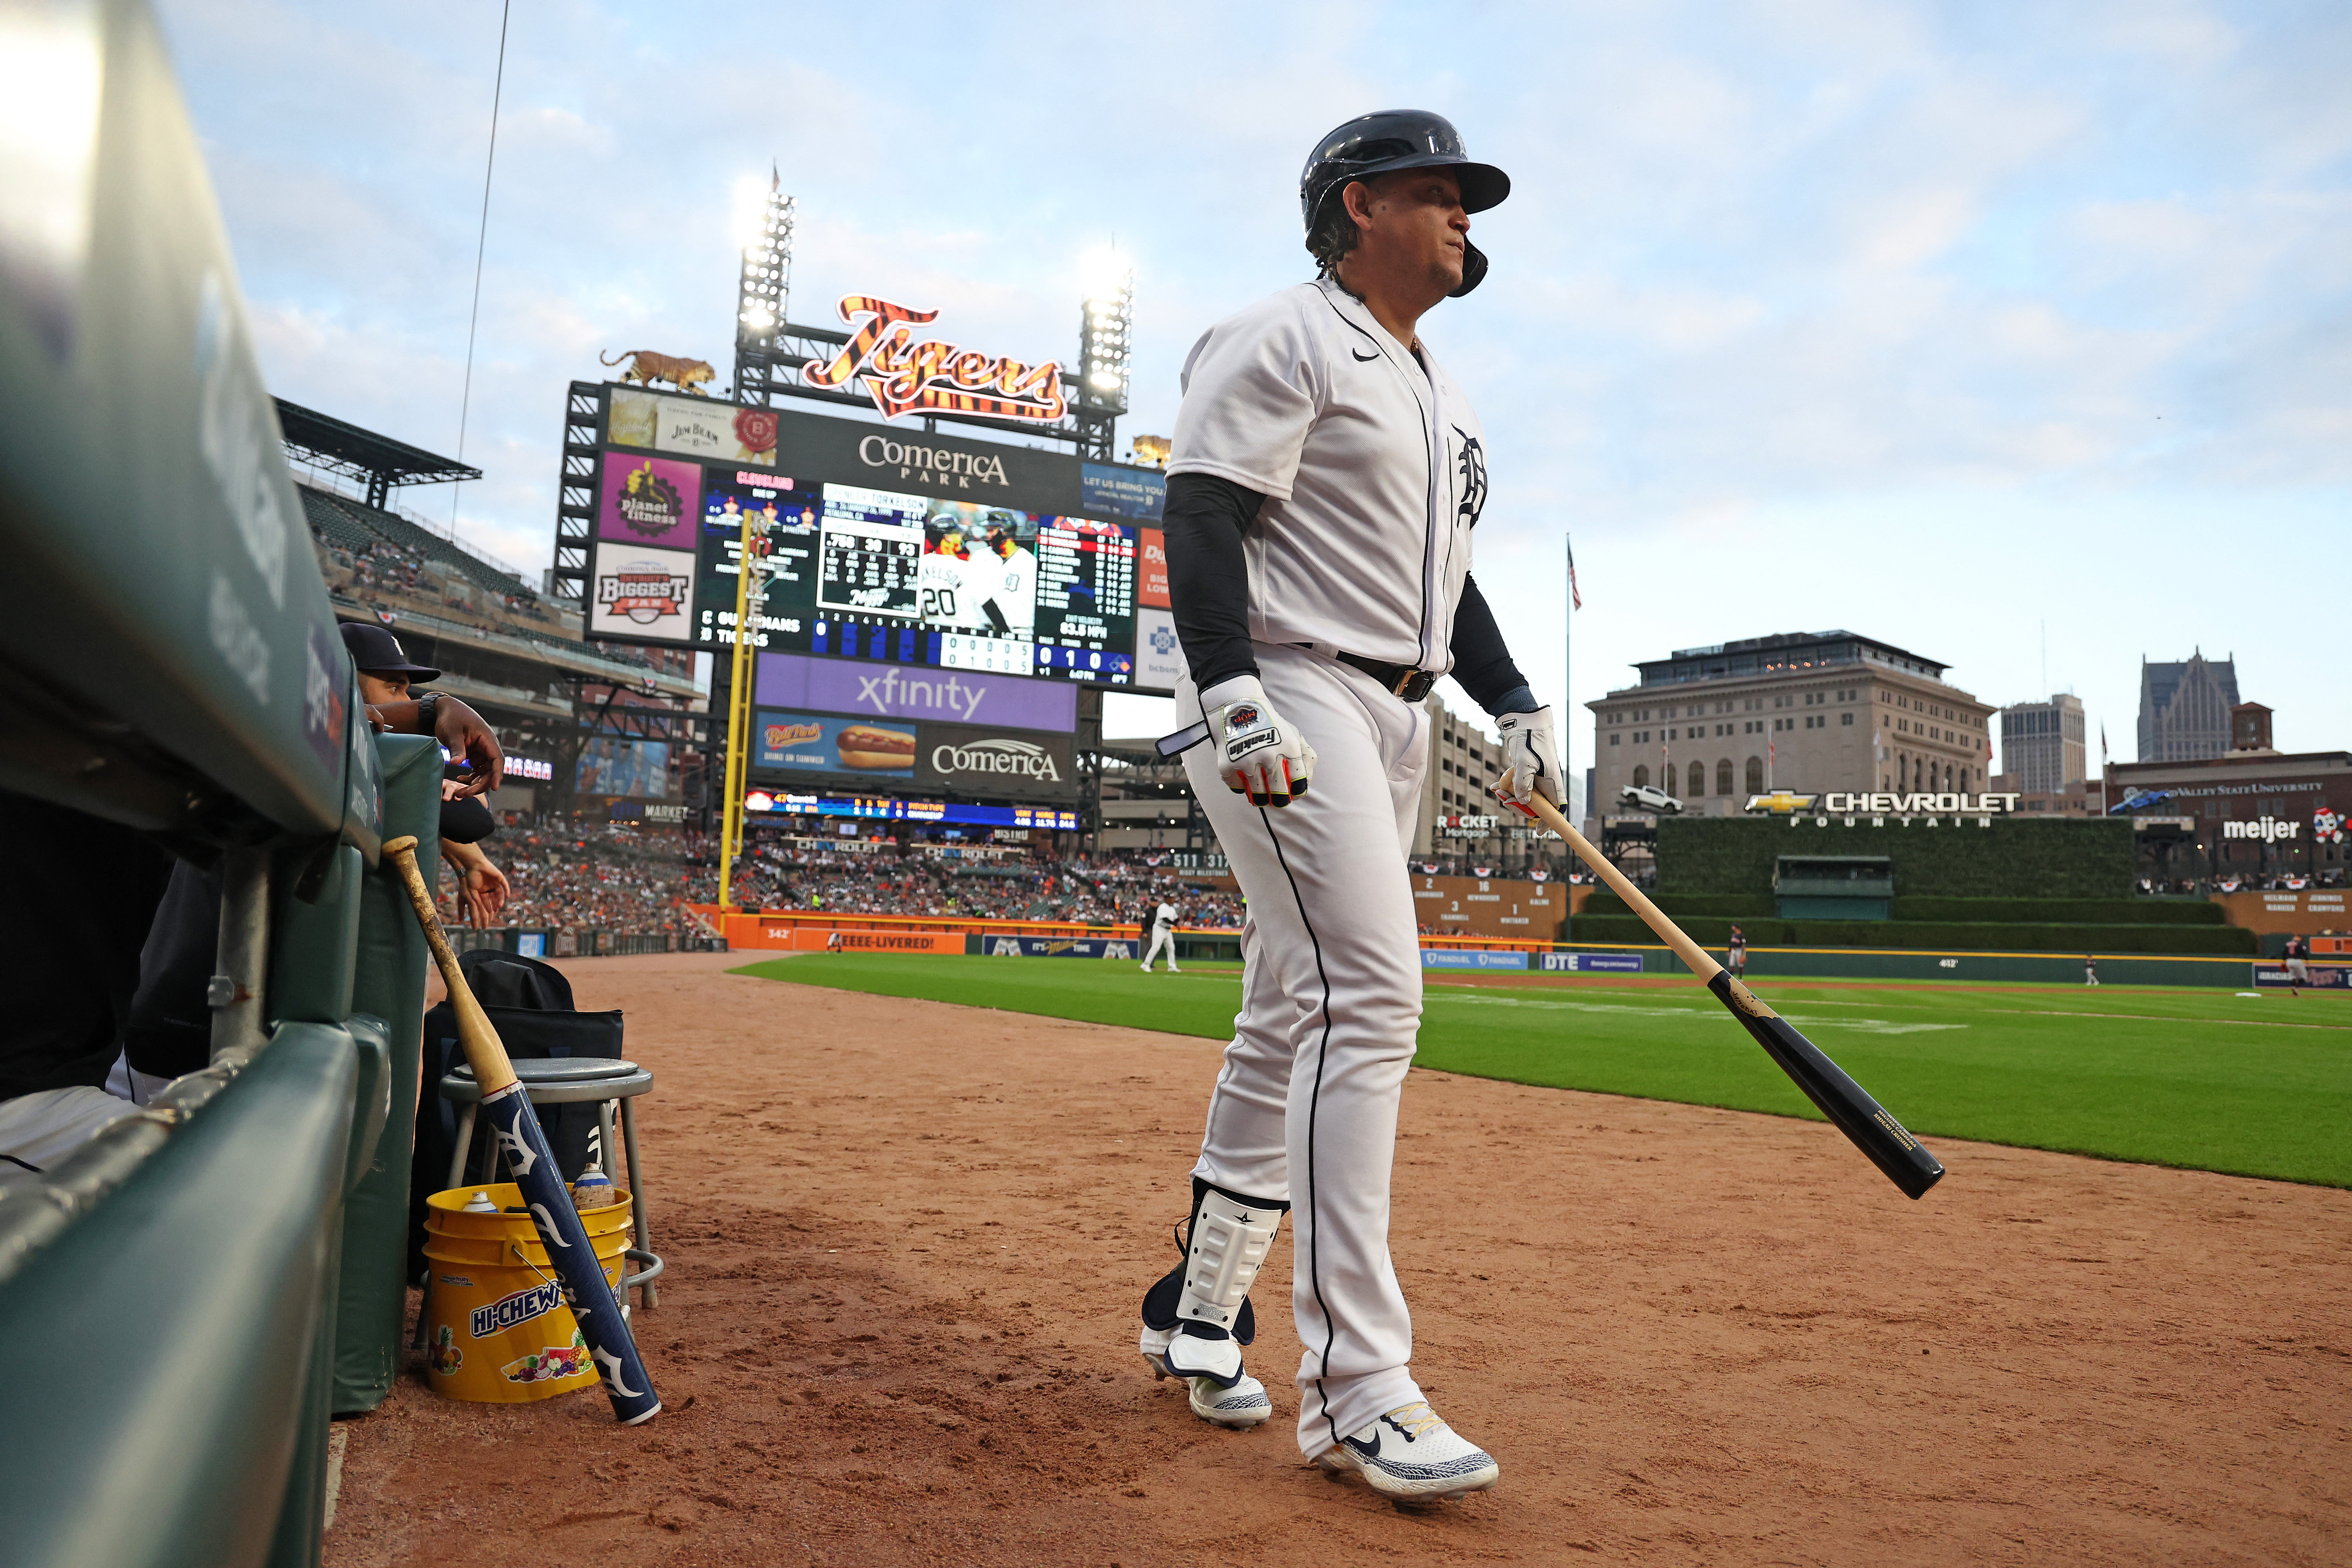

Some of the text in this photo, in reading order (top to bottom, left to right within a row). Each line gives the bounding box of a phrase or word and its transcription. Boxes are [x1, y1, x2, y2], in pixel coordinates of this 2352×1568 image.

[802, 292, 1068, 422] Tigers
[693, 423, 719, 444] BEAM
[736, 471, 794, 491] CLEVELAND
[901, 467, 970, 488] PARK
[1084, 477, 1100, 486] LET
[1102, 479, 1114, 489] US
[826, 488, 867, 501] SPENCER
[621, 497, 668, 514] planet
[627, 508, 677, 525] fitness
[865, 538, 882, 553] 30
[898, 542, 915, 557] 93
[776, 571, 799, 581] NAYLOR
[601, 578, 687, 602] BIGGEST
[628, 598, 662, 607] FAN
[923, 588, 956, 616] 20
[819, 611, 824, 620] 1
[834, 613, 840, 622] 2
[1087, 625, 1107, 639] MPH
[951, 638, 1027, 655] 0 0 0 0 5
[950, 654, 1026, 671] 0 1 0 0 5
[1040, 647, 1101, 669] 0 1 0
[1084, 671, 1095, 681] PM
[856, 668, 986, 720] xfinity
[1234, 711, 1256, 722] MVP
[2178, 782, 2323, 798] VALLEY STATE UNIVERSITY
[774, 794, 787, 803] 47
[1825, 792, 2021, 813] CHEVROLET
[645, 804, 689, 819] MARKET
[1437, 815, 1499, 828] ROCKET
[1790, 816, 1991, 828] FOUNTAIN
[1446, 828, 1490, 839] Mortgage
[2223, 815, 2300, 844] meijer
[797, 840, 882, 853] CHEVROLET
[1174, 853, 1197, 867] 511
[1426, 878, 1433, 889] 2
[1479, 881, 1489, 892] 16
[1536, 885, 1544, 896] 6
[1451, 901, 1459, 912] 3
[1512, 903, 1518, 915] 1
[842, 935, 934, 949] EEEE-LIVERED!
[1545, 954, 1579, 970] DTE
[1733, 991, 1742, 1005] SAM
[1874, 1113, 1892, 1131] RIDEAU
[1891, 1130, 1913, 1151] CRUSHER
[1877, 1110, 1896, 1127] MIGUEL
[1895, 1127, 1917, 1148] CABRERA
[472, 1280, 560, 1337] HI-CHEW
